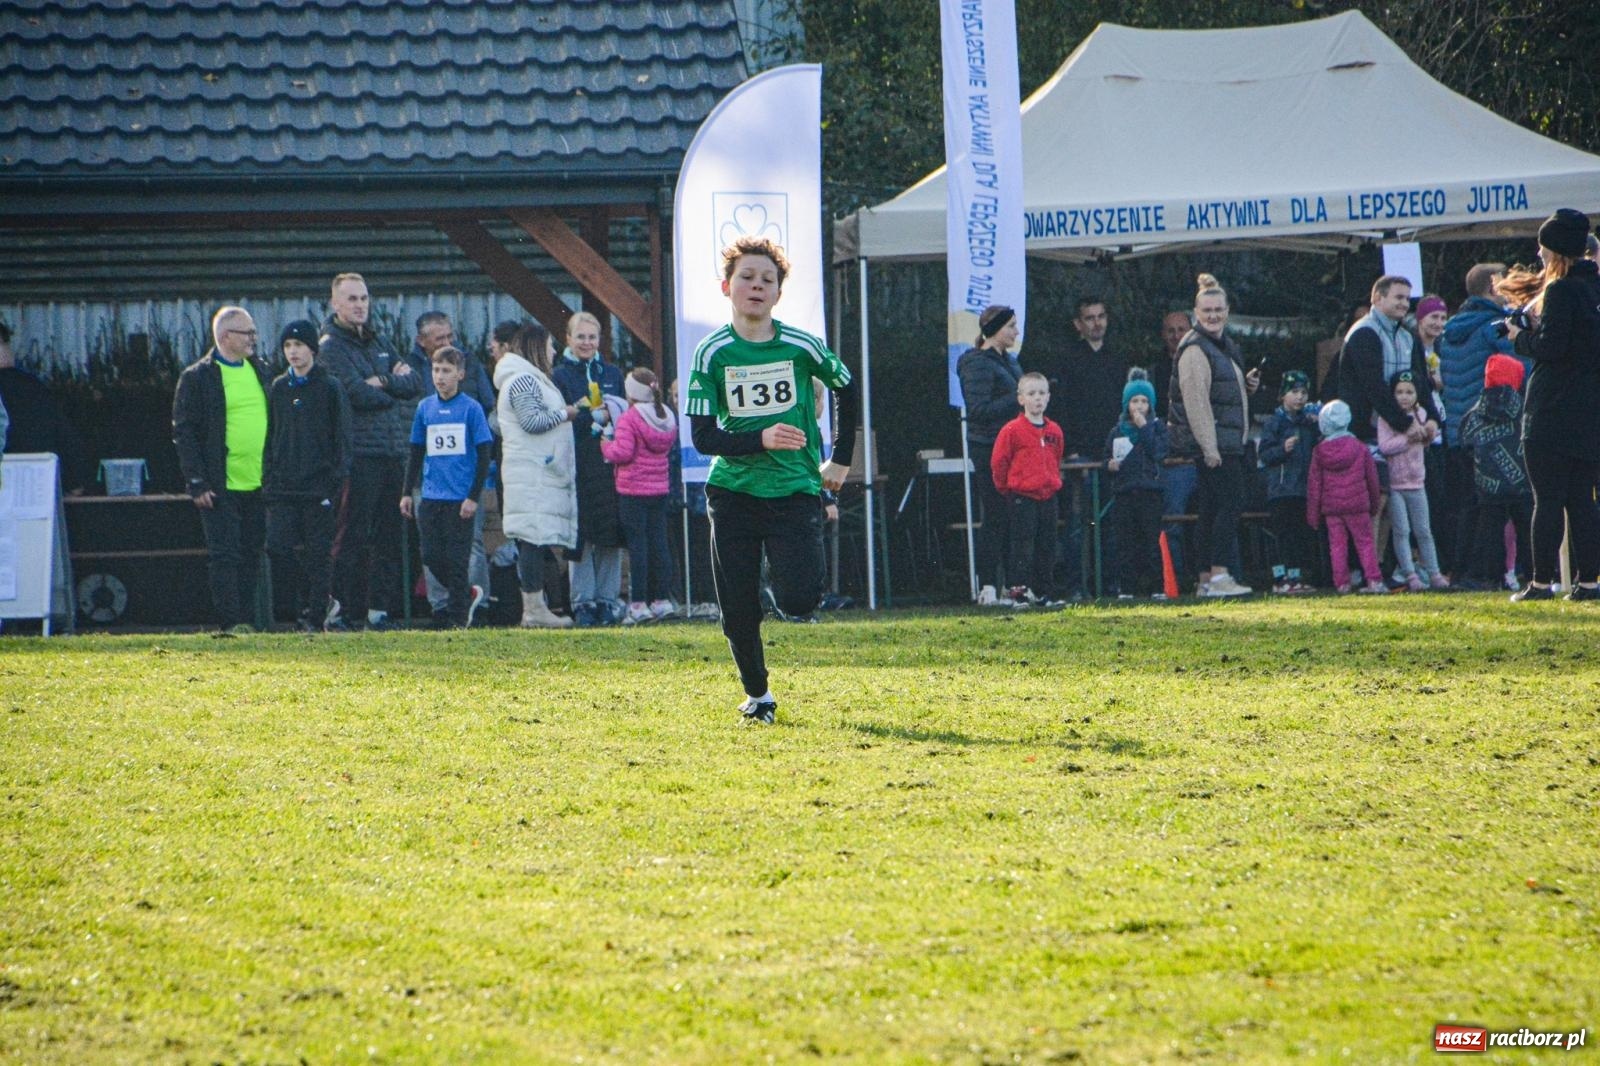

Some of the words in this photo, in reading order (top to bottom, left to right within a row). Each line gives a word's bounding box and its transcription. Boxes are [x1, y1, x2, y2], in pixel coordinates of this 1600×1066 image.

[1186, 199, 1272, 231] AKTYWNI
[1291, 196, 1328, 224] DLA
[1347, 189, 1446, 221] LEPSZEGO
[1467, 183, 1529, 214] JUTRA
[731, 380, 792, 408] 138
[435, 435, 456, 450] 93
